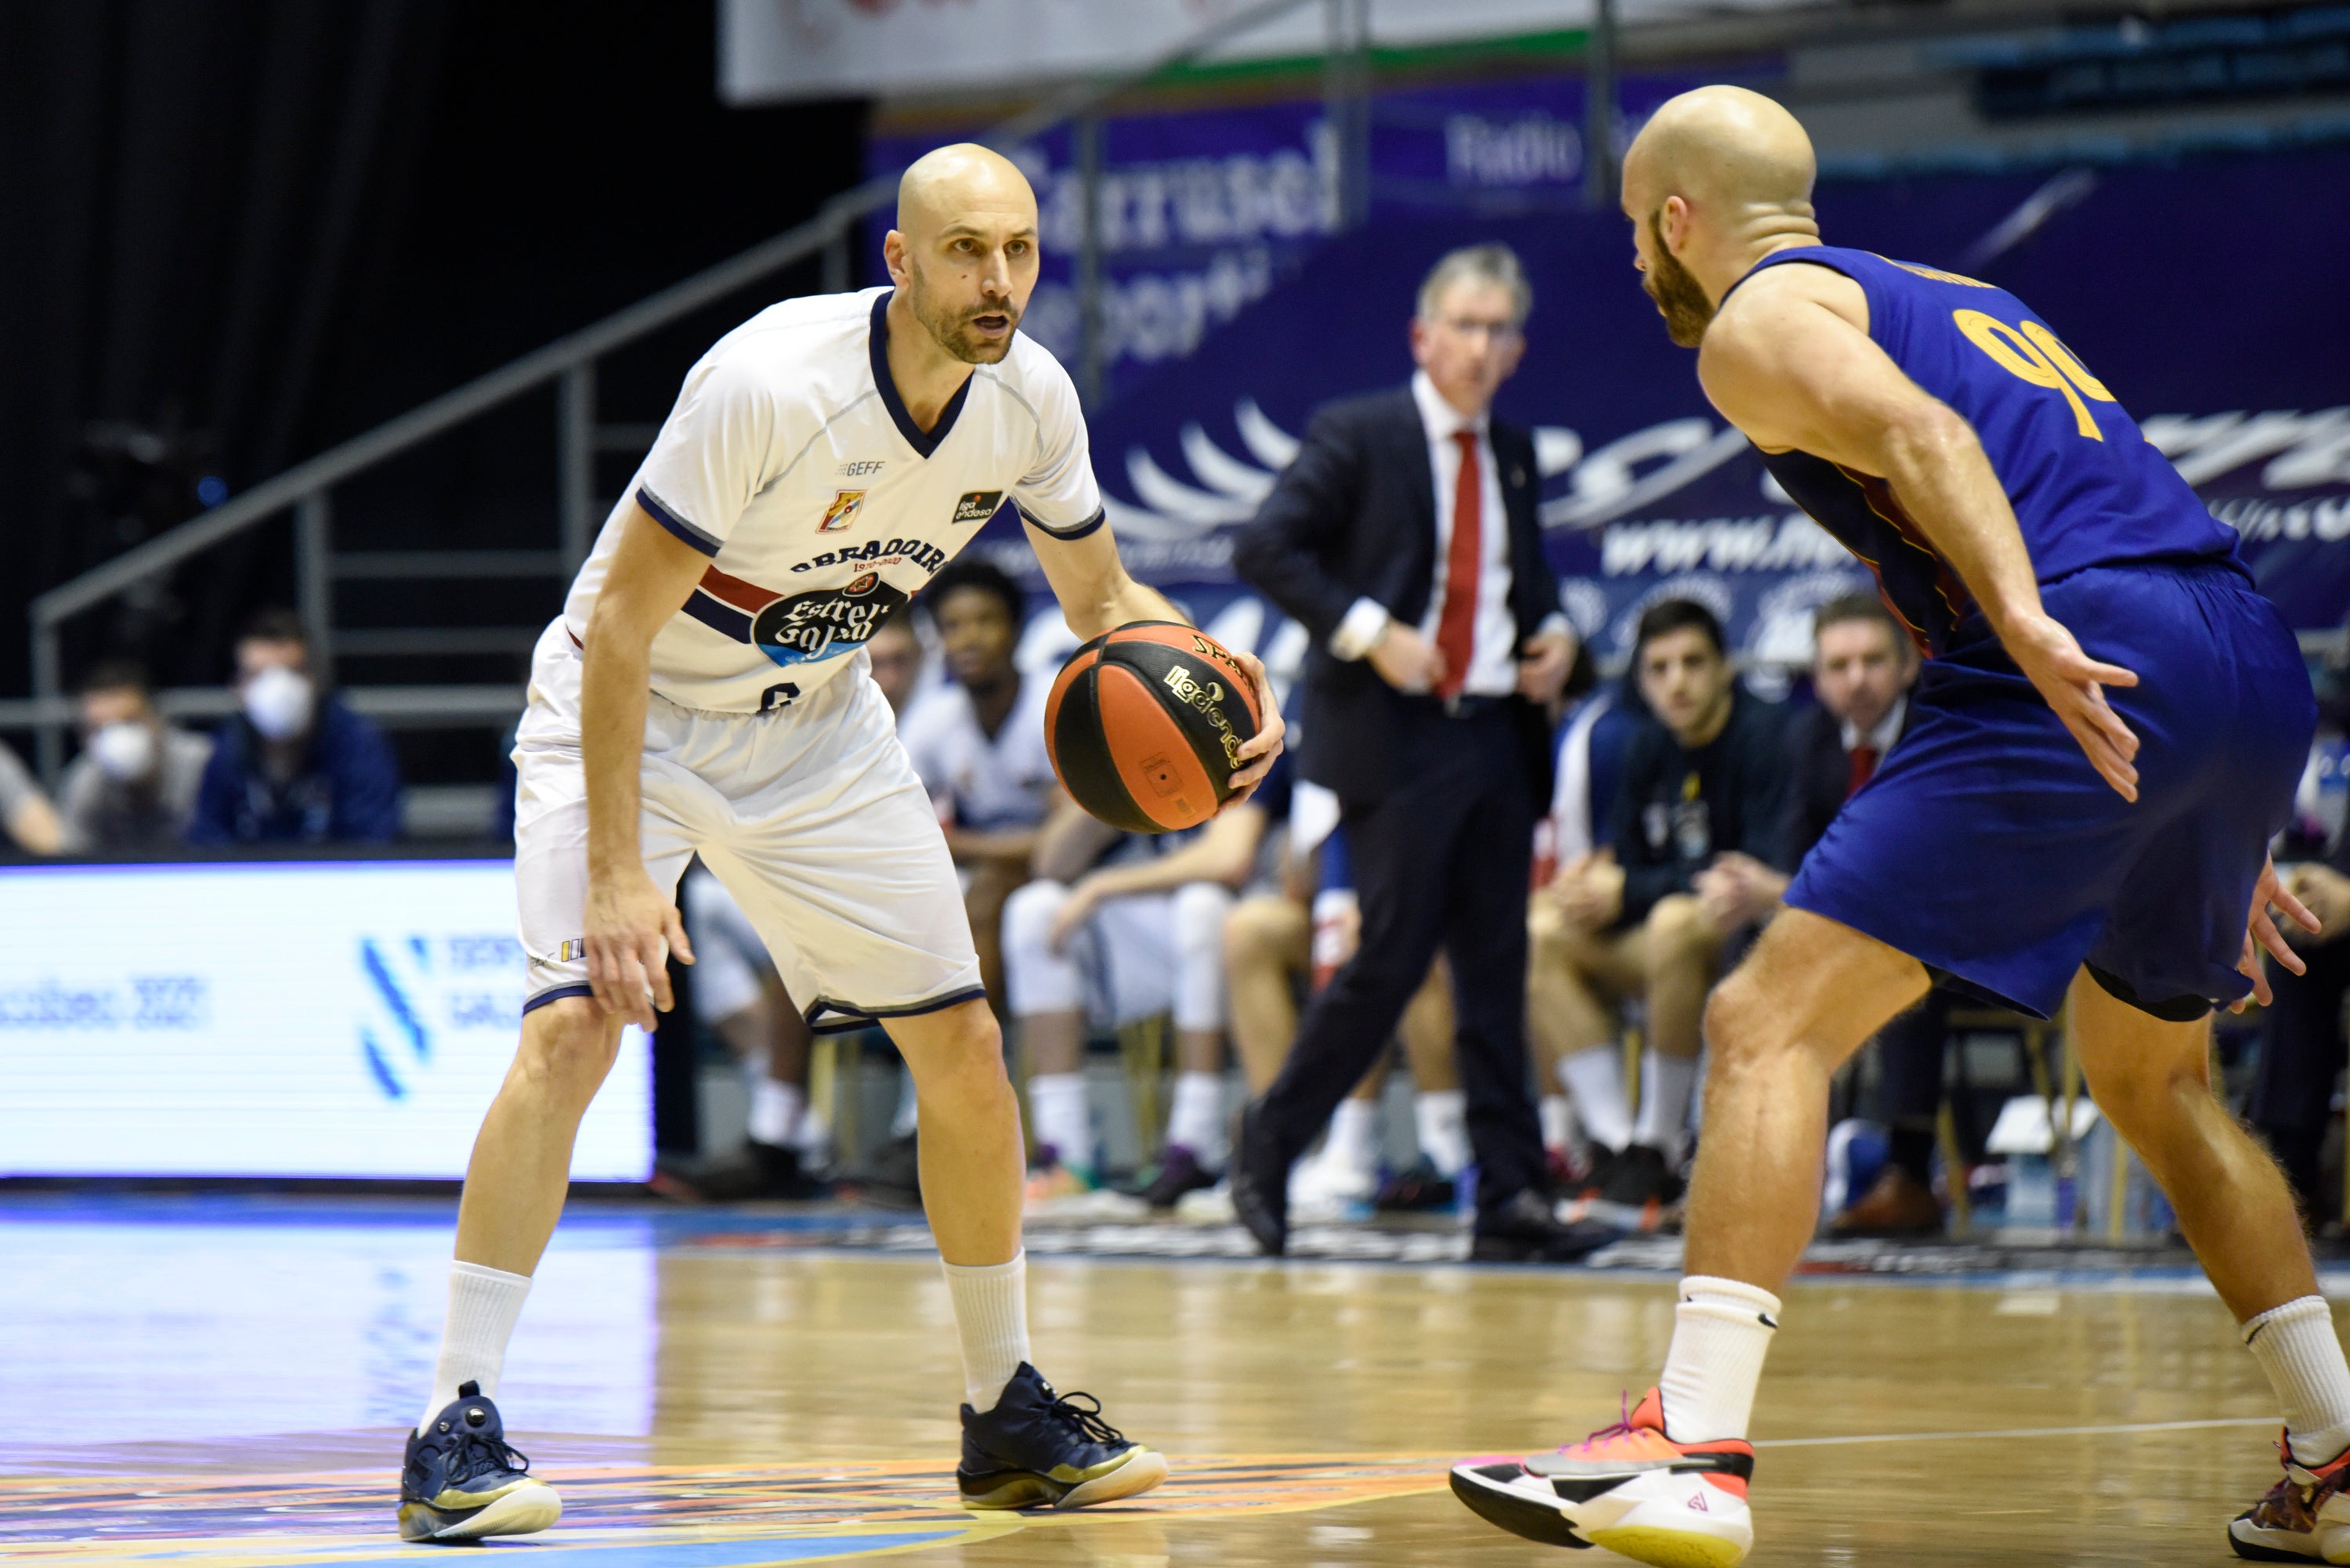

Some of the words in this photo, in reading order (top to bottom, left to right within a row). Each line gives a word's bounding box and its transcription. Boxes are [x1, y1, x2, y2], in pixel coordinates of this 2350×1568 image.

[846, 461, 886, 477] GEFF
[959, 500, 976, 511] liga
[955, 508, 992, 520] endesa
